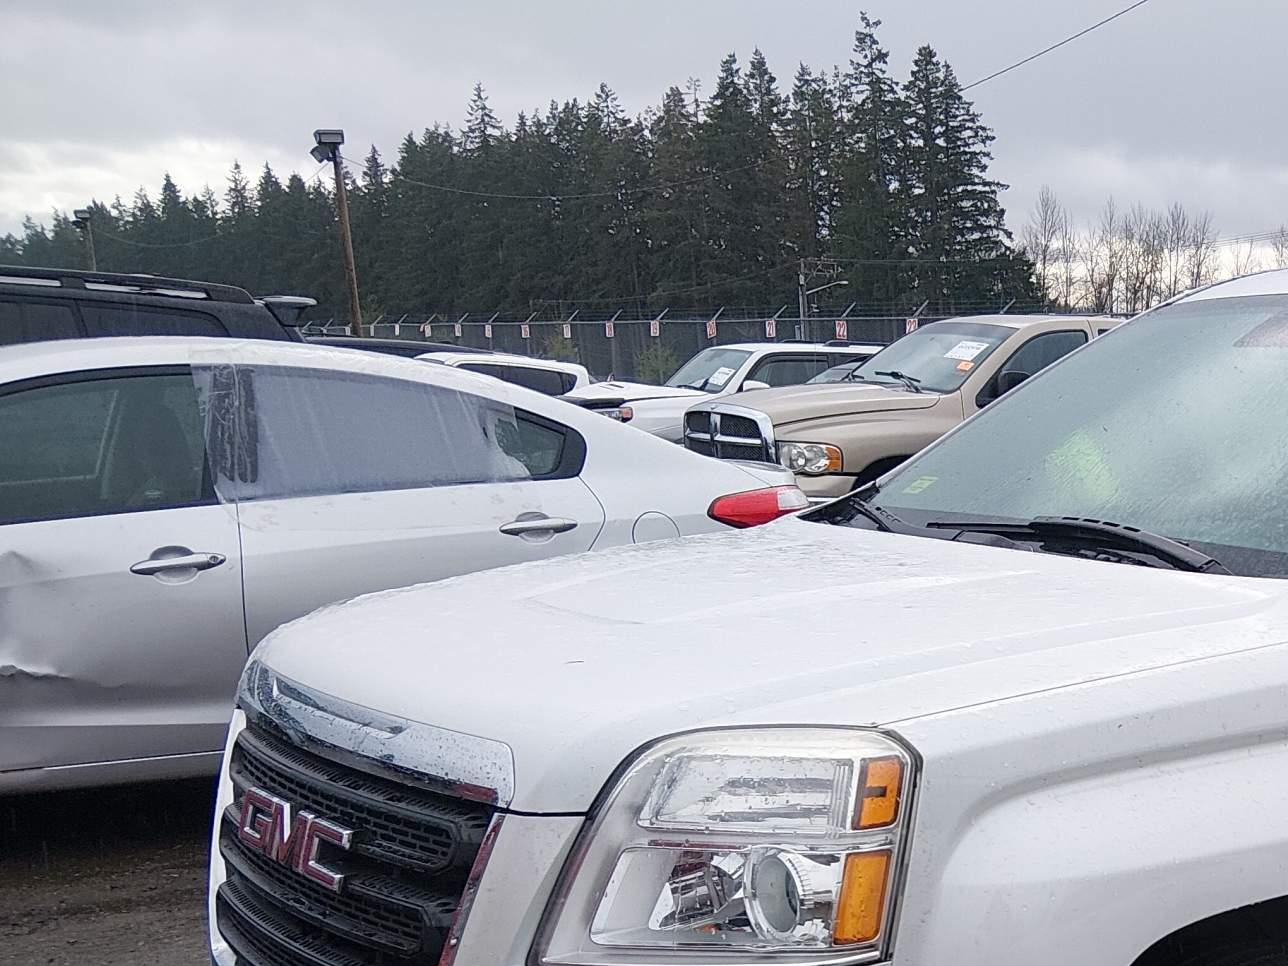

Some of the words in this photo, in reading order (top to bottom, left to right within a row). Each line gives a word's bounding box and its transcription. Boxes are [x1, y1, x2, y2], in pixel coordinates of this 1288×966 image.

[767, 320, 775, 337] 21
[836, 322, 846, 338] 22
[239, 786, 354, 894] GMC
